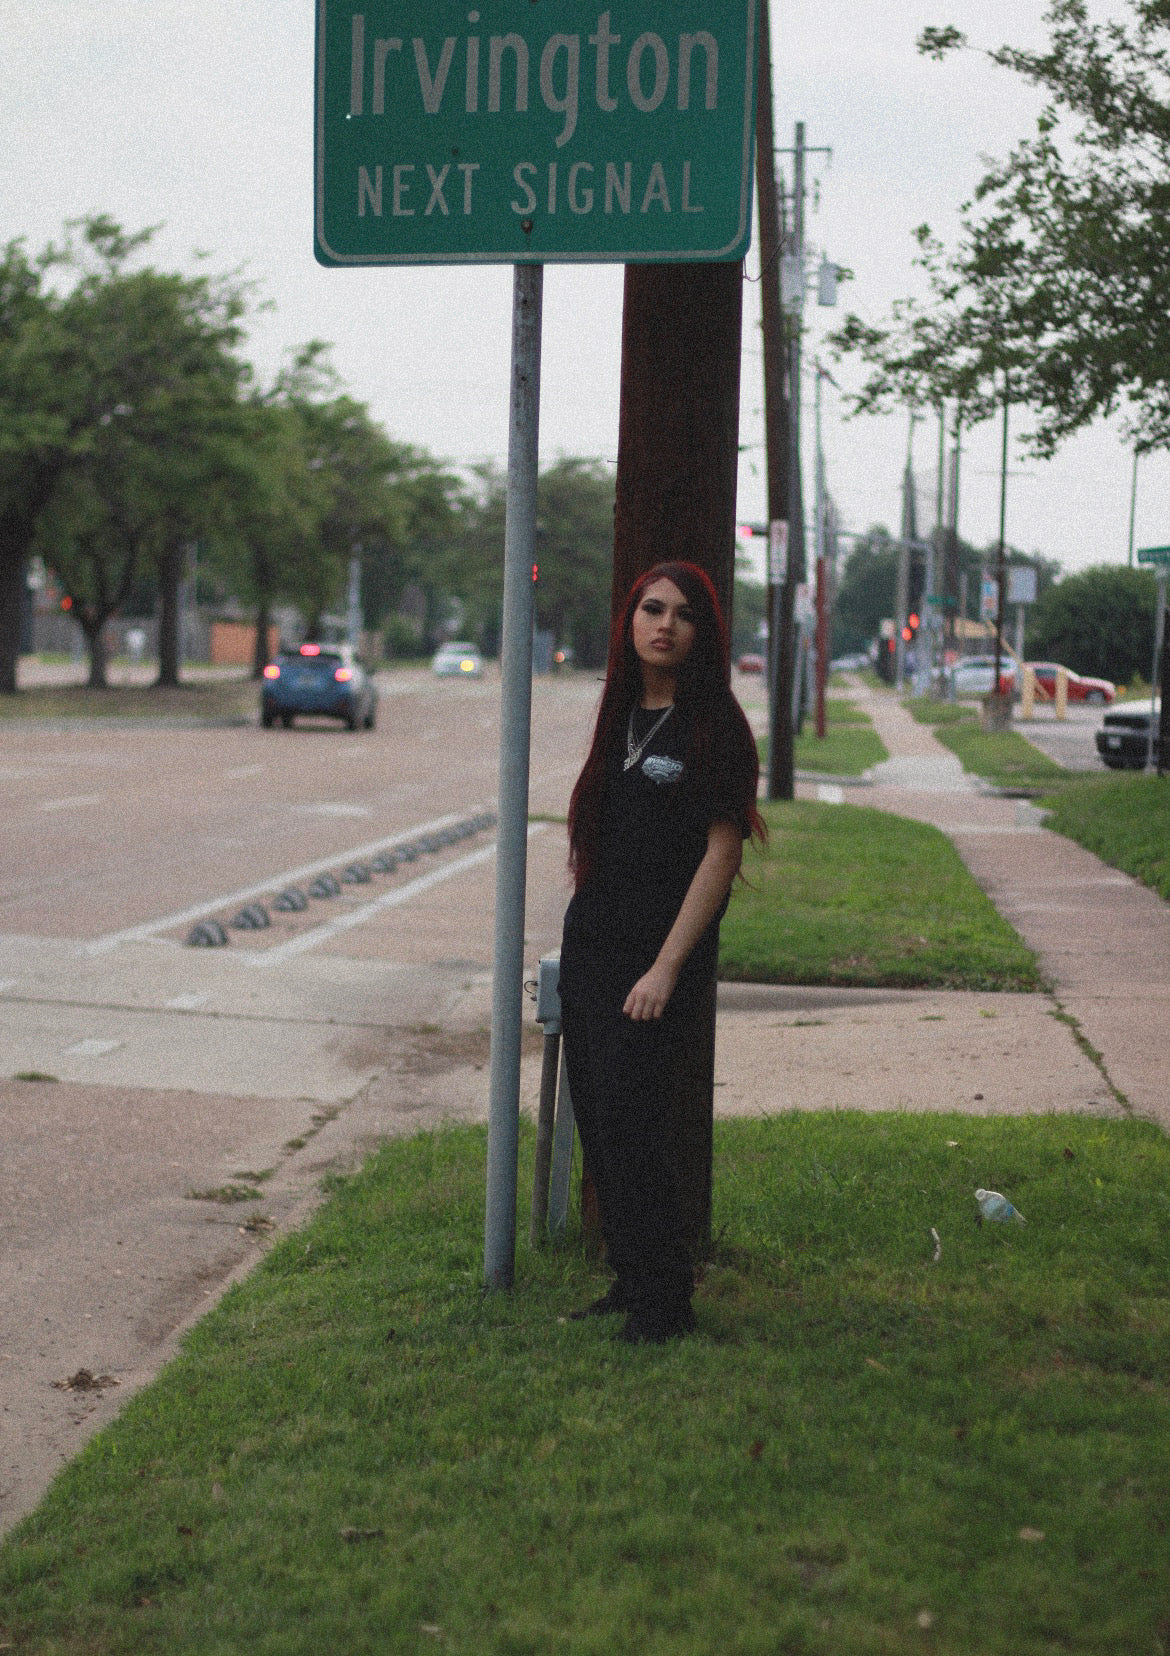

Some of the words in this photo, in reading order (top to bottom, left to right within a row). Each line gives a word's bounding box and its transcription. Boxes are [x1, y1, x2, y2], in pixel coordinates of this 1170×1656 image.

[350, 10, 719, 148] Irvington
[357, 163, 480, 217] NEXT
[510, 161, 705, 215] SIGNAL
